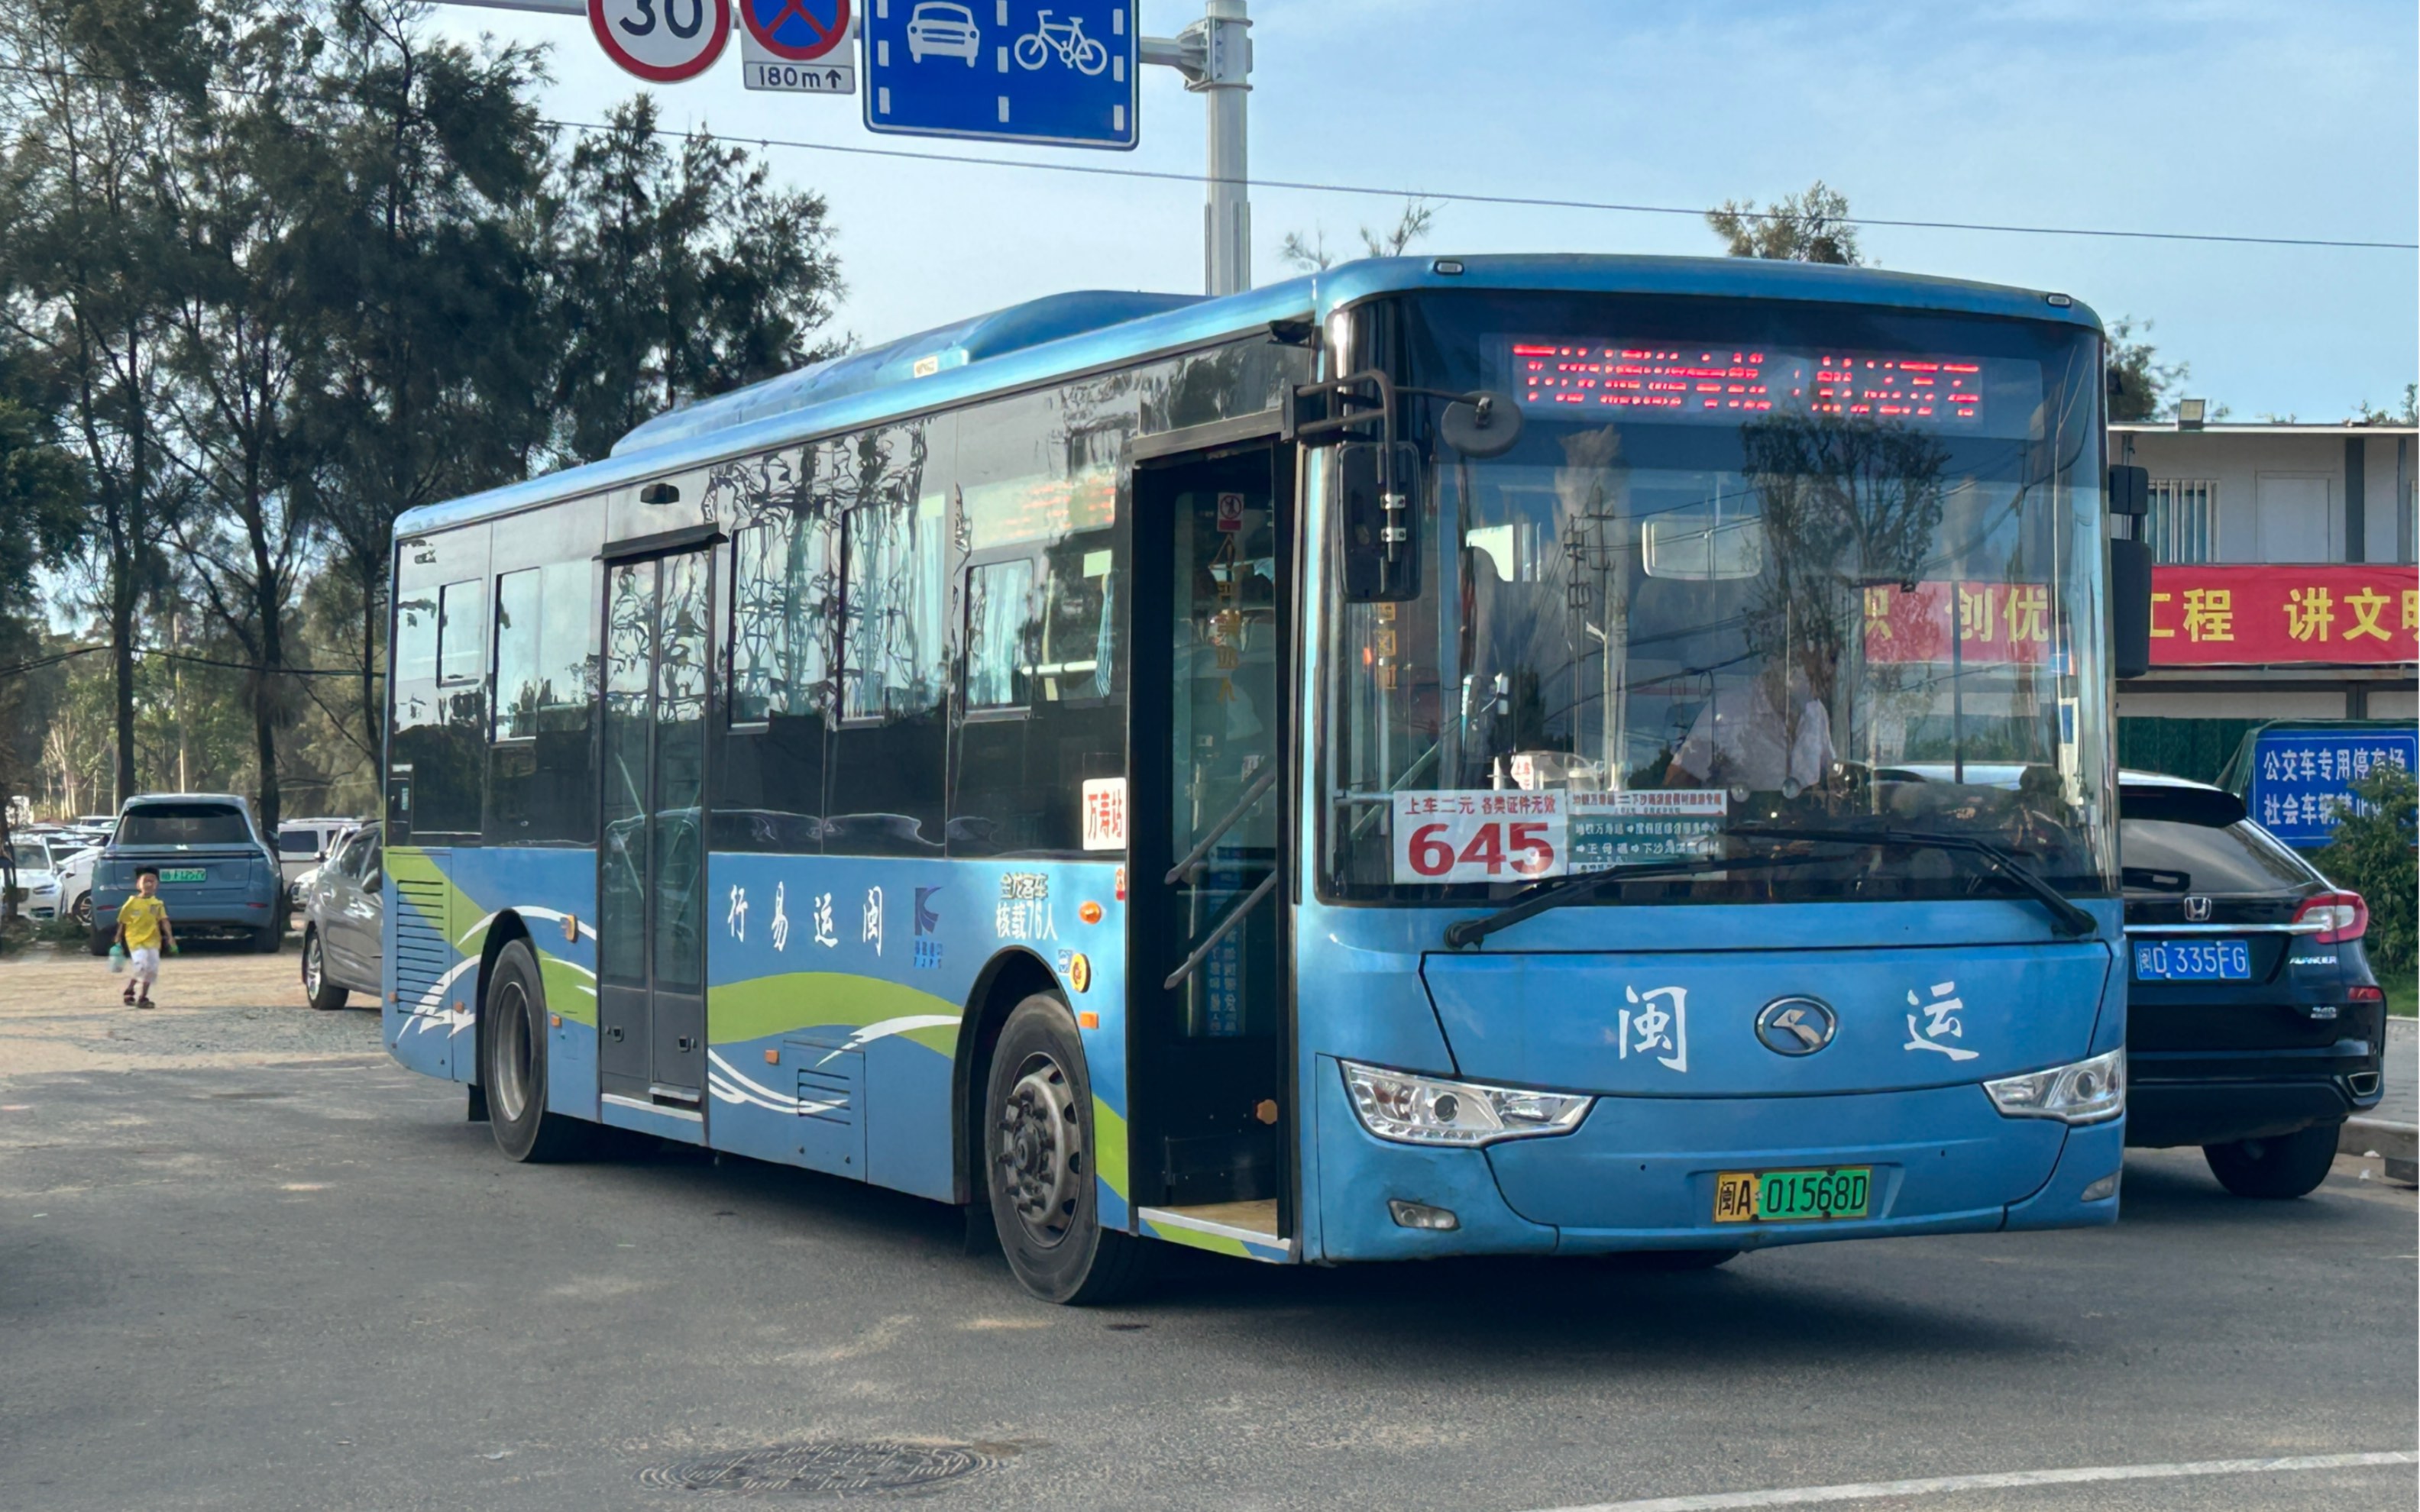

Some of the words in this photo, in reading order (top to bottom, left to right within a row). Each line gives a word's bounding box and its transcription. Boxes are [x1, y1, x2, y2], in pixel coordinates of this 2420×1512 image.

[619, 0, 704, 39] 30
[759, 66, 821, 89] 180m
[2263, 747, 2405, 783] 公交车专用停车场
[1405, 796, 1475, 816] 上车二元
[1481, 795, 1556, 815] 各类证件无效
[1408, 822, 1555, 877] 645
[995, 900, 1059, 941] 核载76人
[1618, 985, 1688, 1073] 闽
[1904, 981, 1980, 1062] 运
